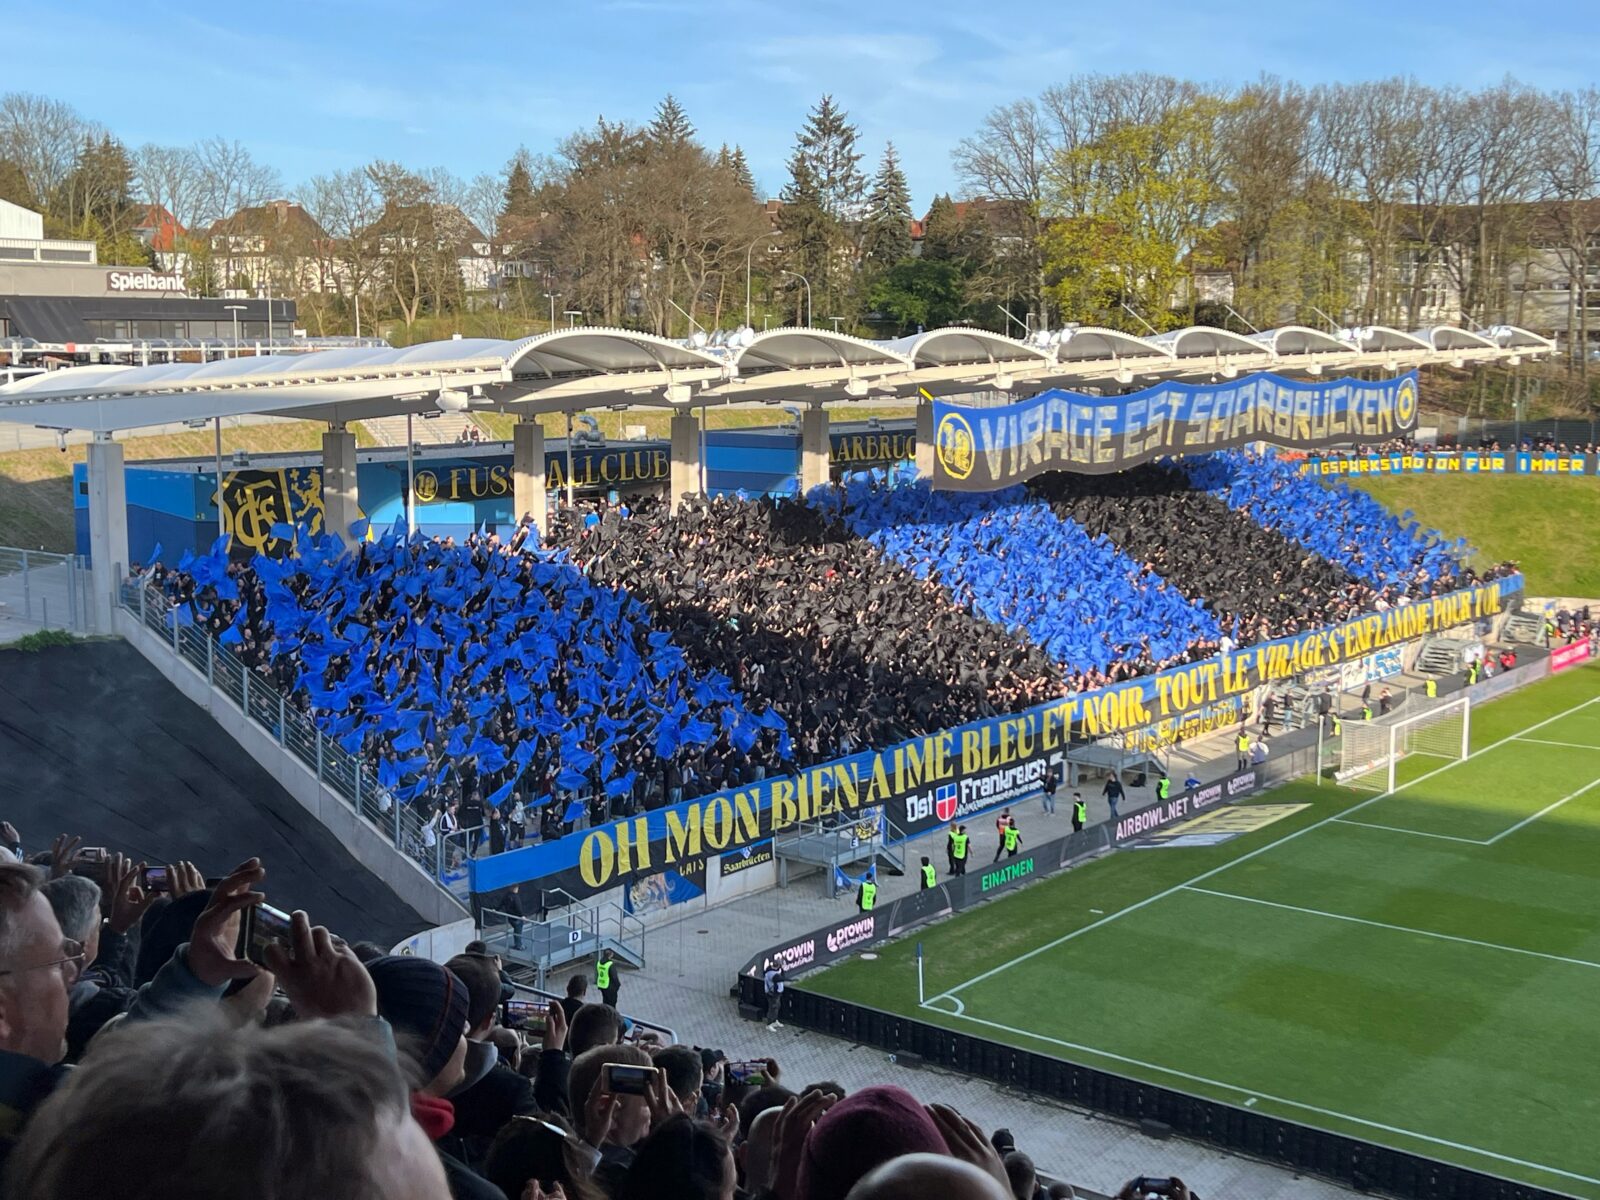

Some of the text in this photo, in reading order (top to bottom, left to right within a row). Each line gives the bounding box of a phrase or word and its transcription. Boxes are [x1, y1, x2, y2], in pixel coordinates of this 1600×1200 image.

[110, 272, 186, 291] Spielbank
[980, 378, 1394, 480] VIRAGE EST SAARBRÜCKEN
[1521, 458, 1584, 472] IMMER
[579, 816, 652, 888] OH
[665, 788, 761, 864] MON
[962, 714, 1035, 775] BLEU
[1043, 701, 1078, 752] ET
[1156, 663, 1220, 715] TOUT
[1222, 654, 1250, 695] LE
[1257, 631, 1327, 681] VIRAGE
[1433, 591, 1472, 630] POUR
[960, 758, 1047, 803] Frankreich
[1116, 797, 1188, 841] AIRBOWL.NET
[982, 857, 1034, 892] EINATMEN
